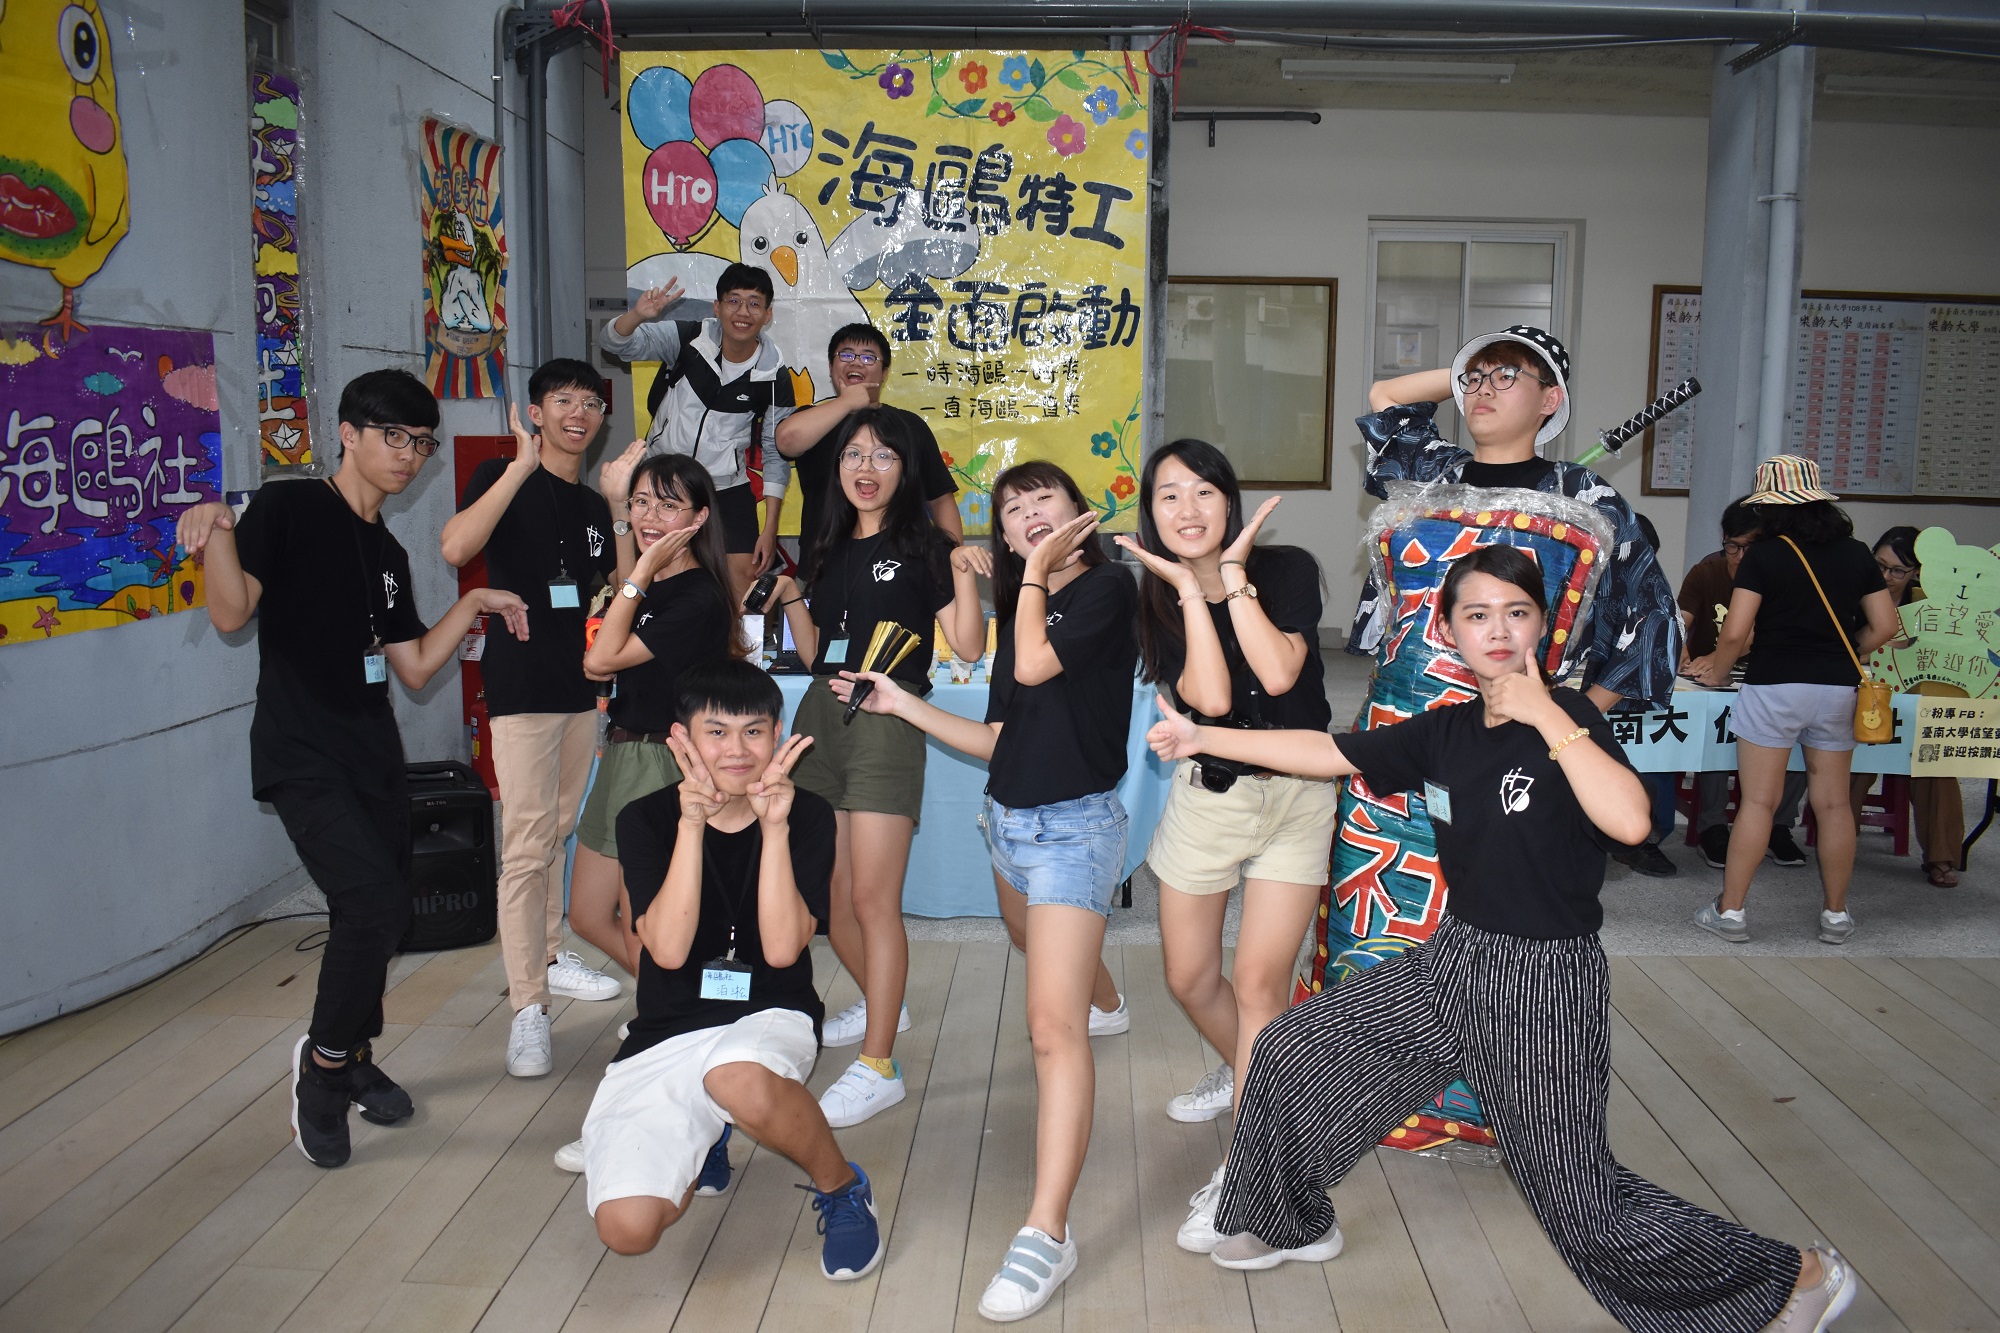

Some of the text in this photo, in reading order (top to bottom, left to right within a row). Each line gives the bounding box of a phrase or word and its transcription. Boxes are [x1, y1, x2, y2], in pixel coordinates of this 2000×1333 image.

[817, 120, 1134, 250] 海鷗特工
[1914, 603, 1995, 643] 信望愛
[1915, 648, 1990, 677] 歡迎你
